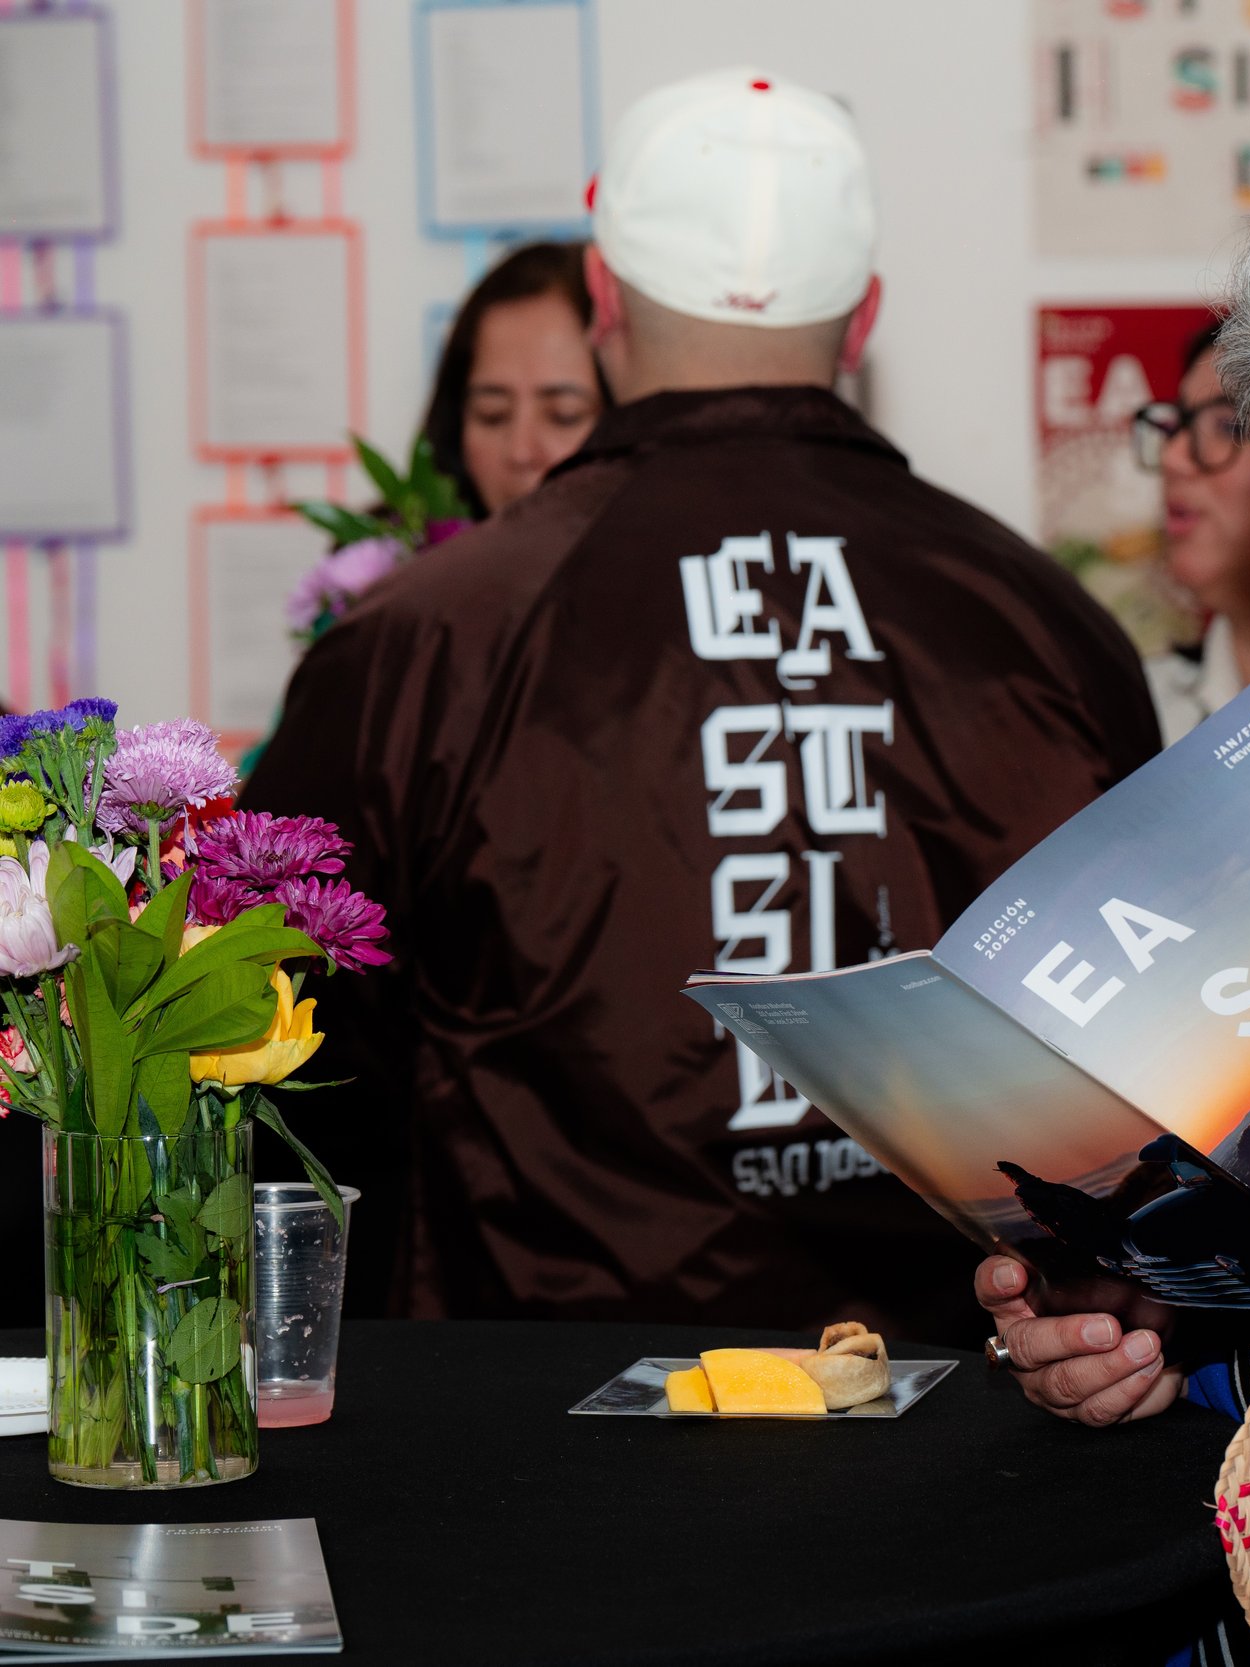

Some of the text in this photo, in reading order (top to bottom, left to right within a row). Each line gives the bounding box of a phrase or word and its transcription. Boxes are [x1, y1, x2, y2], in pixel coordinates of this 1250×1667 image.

[973, 898, 1027, 952] EDICIÓN
[1021, 897, 1196, 1028] EA
[116, 1610, 301, 1634] DE
